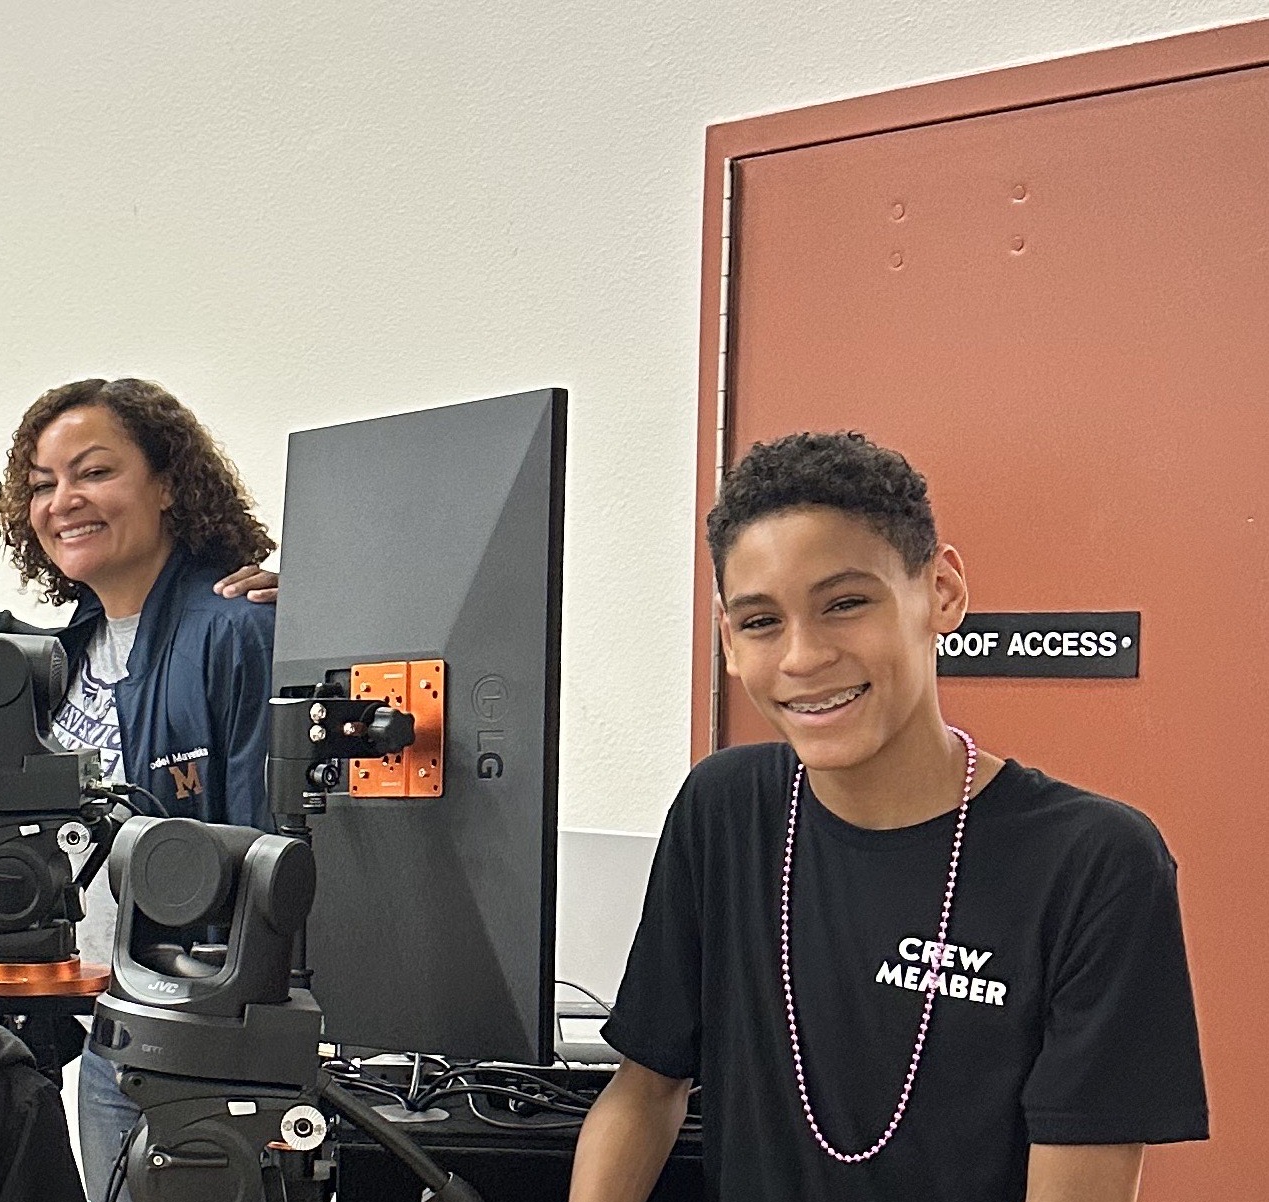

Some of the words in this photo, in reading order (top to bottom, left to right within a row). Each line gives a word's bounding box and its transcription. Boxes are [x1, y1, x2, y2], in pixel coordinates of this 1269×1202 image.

[935, 632, 998, 656] ROOF
[1007, 631, 1117, 657] ACCESS
[169, 761, 204, 800] M
[898, 937, 993, 973] CREW
[147, 980, 179, 995] JVC
[875, 960, 1007, 1006] MEMBER
